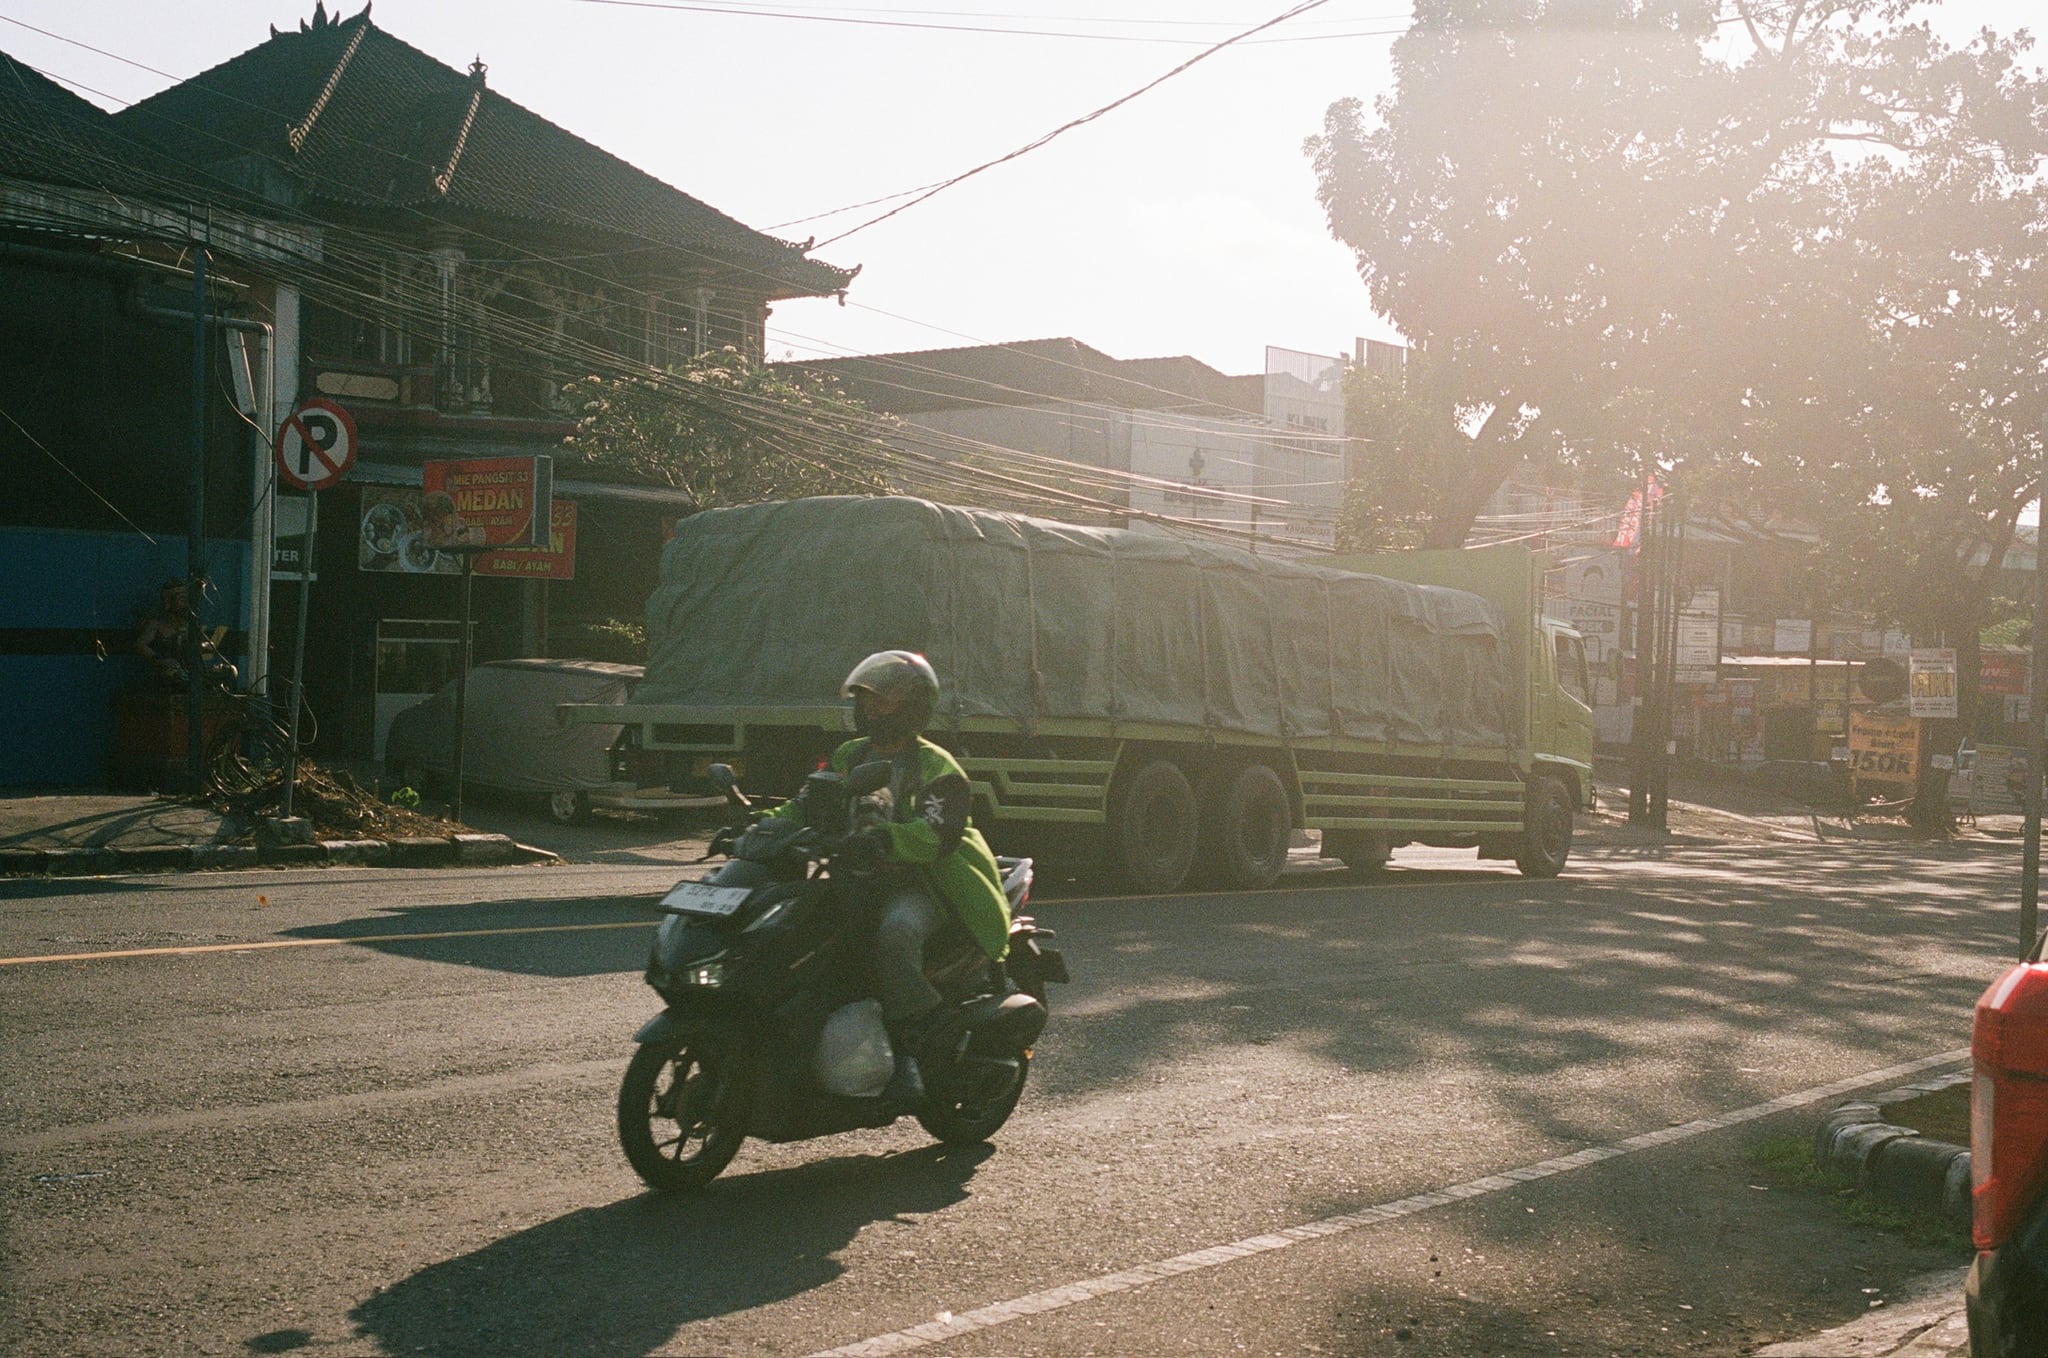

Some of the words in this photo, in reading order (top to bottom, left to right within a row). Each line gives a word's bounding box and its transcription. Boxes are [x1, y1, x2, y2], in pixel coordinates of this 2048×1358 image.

[472, 472, 514, 485] PANGSIT
[517, 472, 529, 482] 33
[457, 488, 525, 512] MEDAN
[491, 514, 513, 526] AYAM
[493, 559, 516, 571] BABI
[525, 560, 552, 572] AYAM
[1569, 605, 1616, 617] FACIAL
